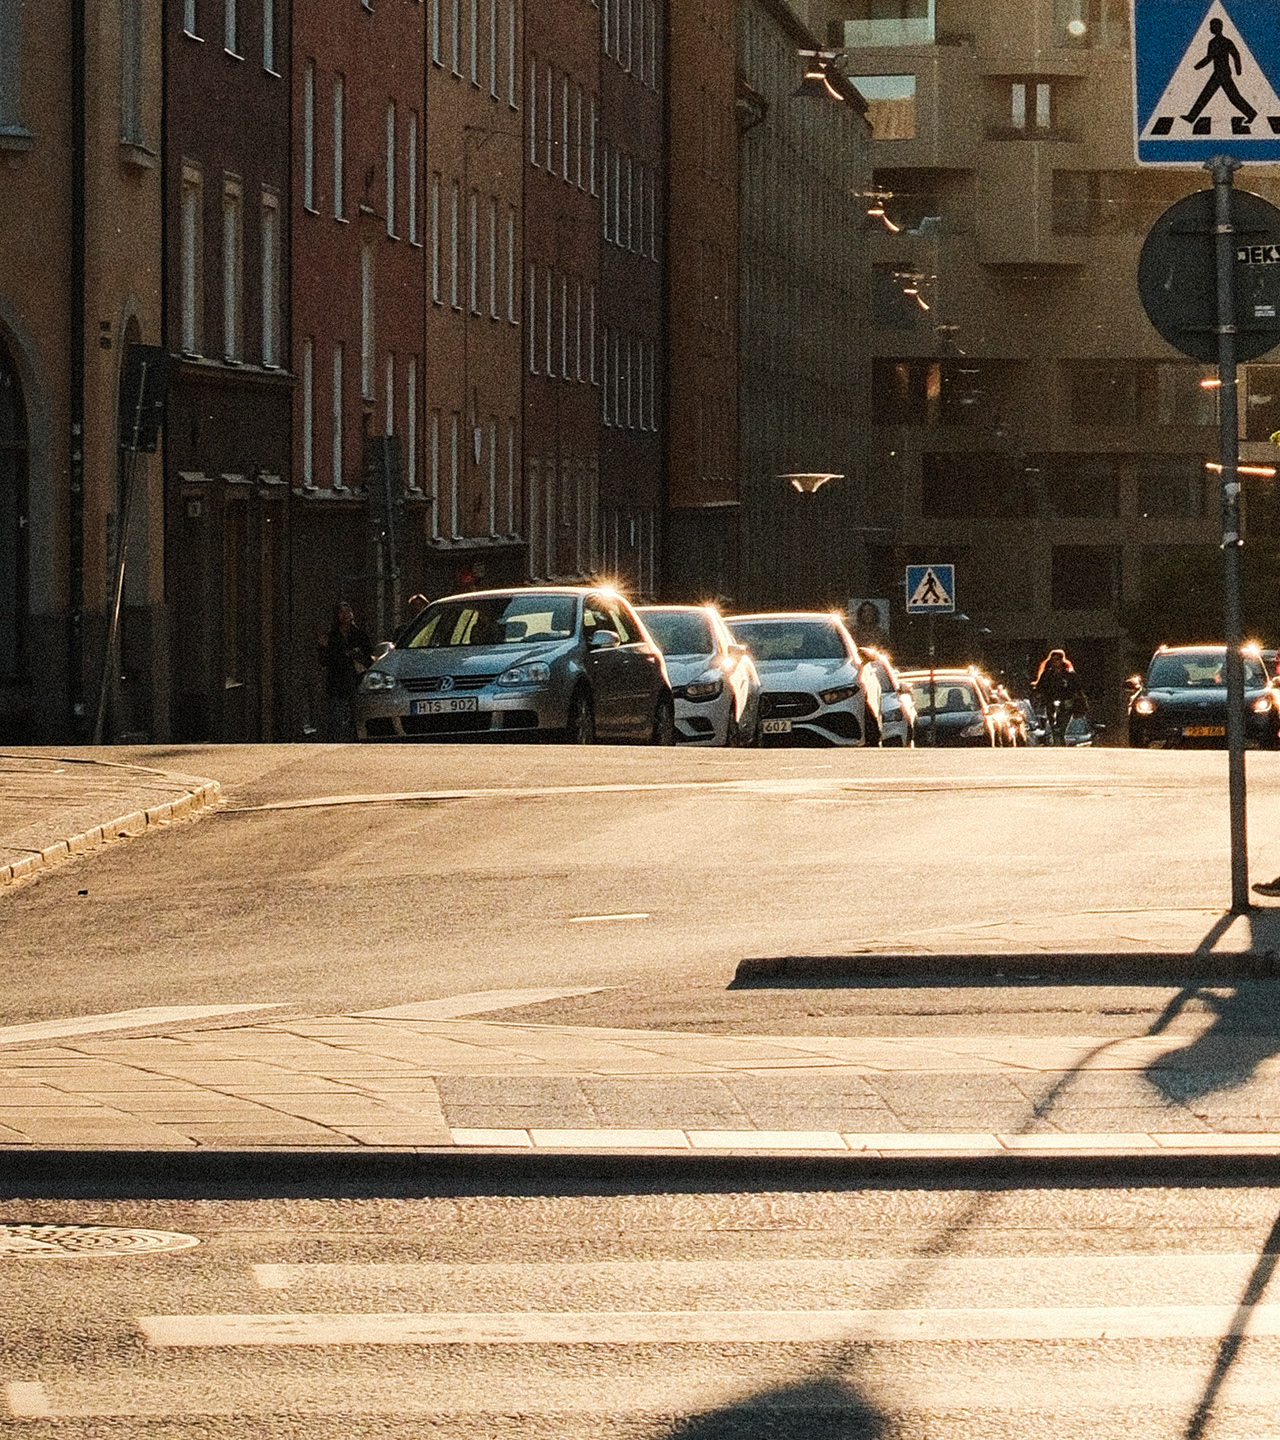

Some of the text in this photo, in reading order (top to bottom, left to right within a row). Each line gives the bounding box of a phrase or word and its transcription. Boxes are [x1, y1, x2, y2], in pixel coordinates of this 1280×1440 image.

[419, 698, 474, 713] HTS 902
[765, 720, 787, 732] 602
